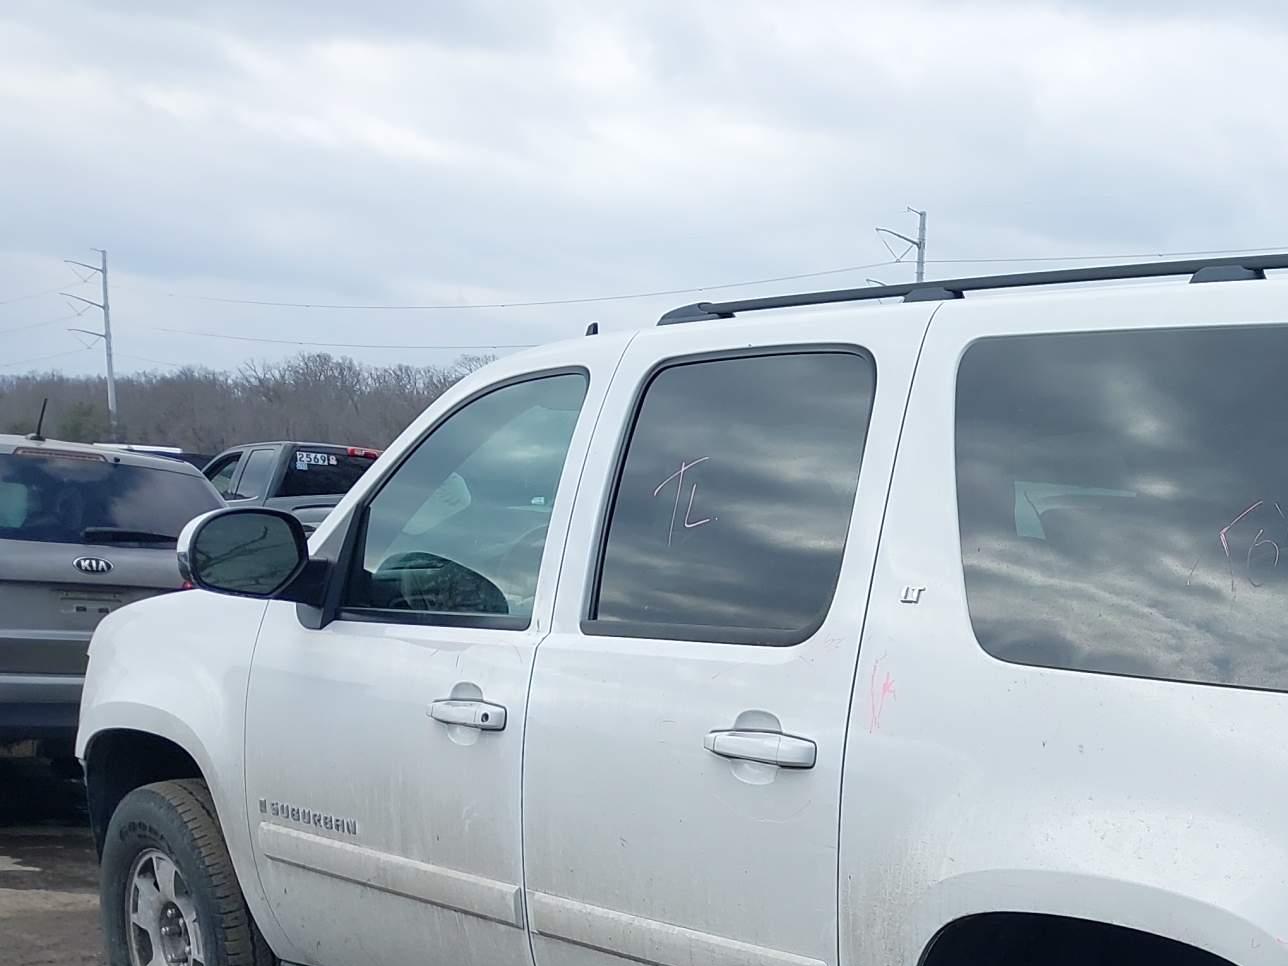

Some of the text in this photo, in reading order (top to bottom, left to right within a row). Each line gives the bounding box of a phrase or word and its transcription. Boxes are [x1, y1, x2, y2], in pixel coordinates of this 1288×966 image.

[298, 452, 327, 465] 2569
[80, 559, 108, 571] KIA
[899, 586, 927, 605] LT
[271, 802, 358, 835] SUBURBAN
